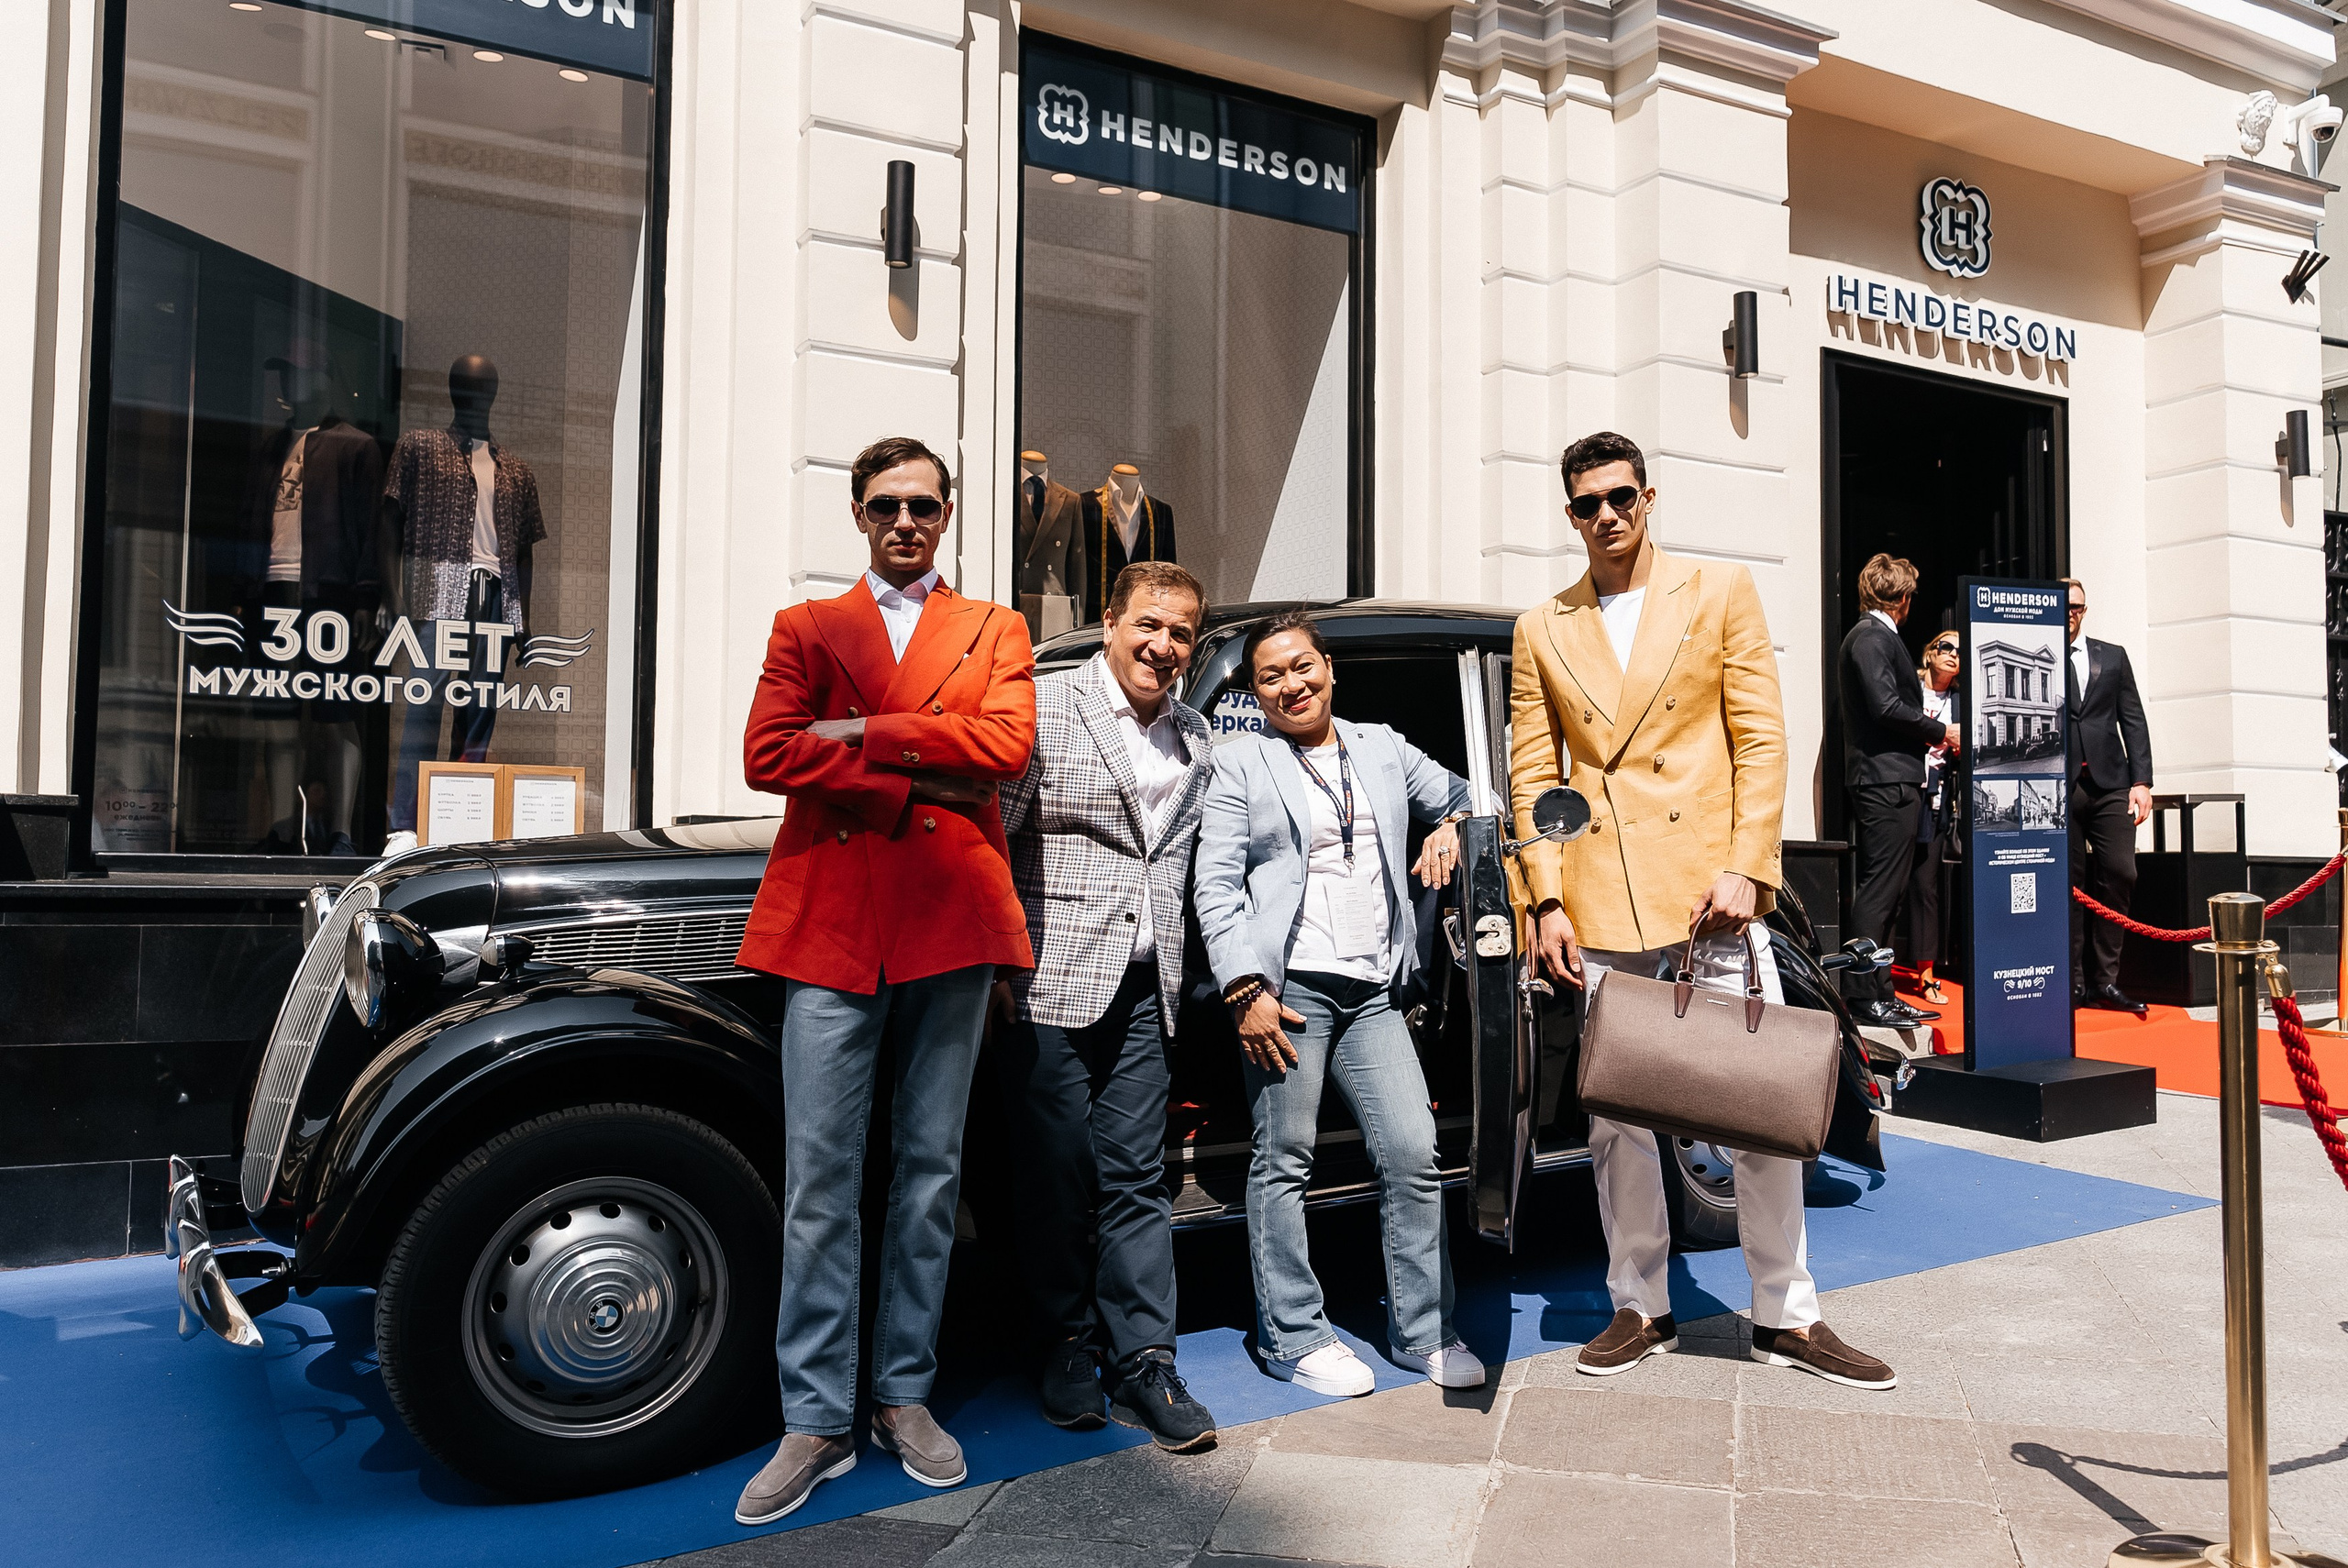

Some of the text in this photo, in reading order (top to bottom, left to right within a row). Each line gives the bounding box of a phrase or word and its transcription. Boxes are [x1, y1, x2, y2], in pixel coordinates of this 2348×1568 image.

[1102, 109, 1346, 193] HENDERSON
[1830, 275, 2076, 361] HENDERSON
[1992, 592, 2057, 606] HENDERSON
[261, 606, 515, 673] 30 ЛЕТ
[188, 666, 571, 712] МУЖСКОГО СТИЛЯ
[1993, 965, 2054, 980] КУЗНЕЦКИЙ МОСТ
[2017, 978, 2032, 989] 9/10
[590, 1301, 604, 1330] BMW
